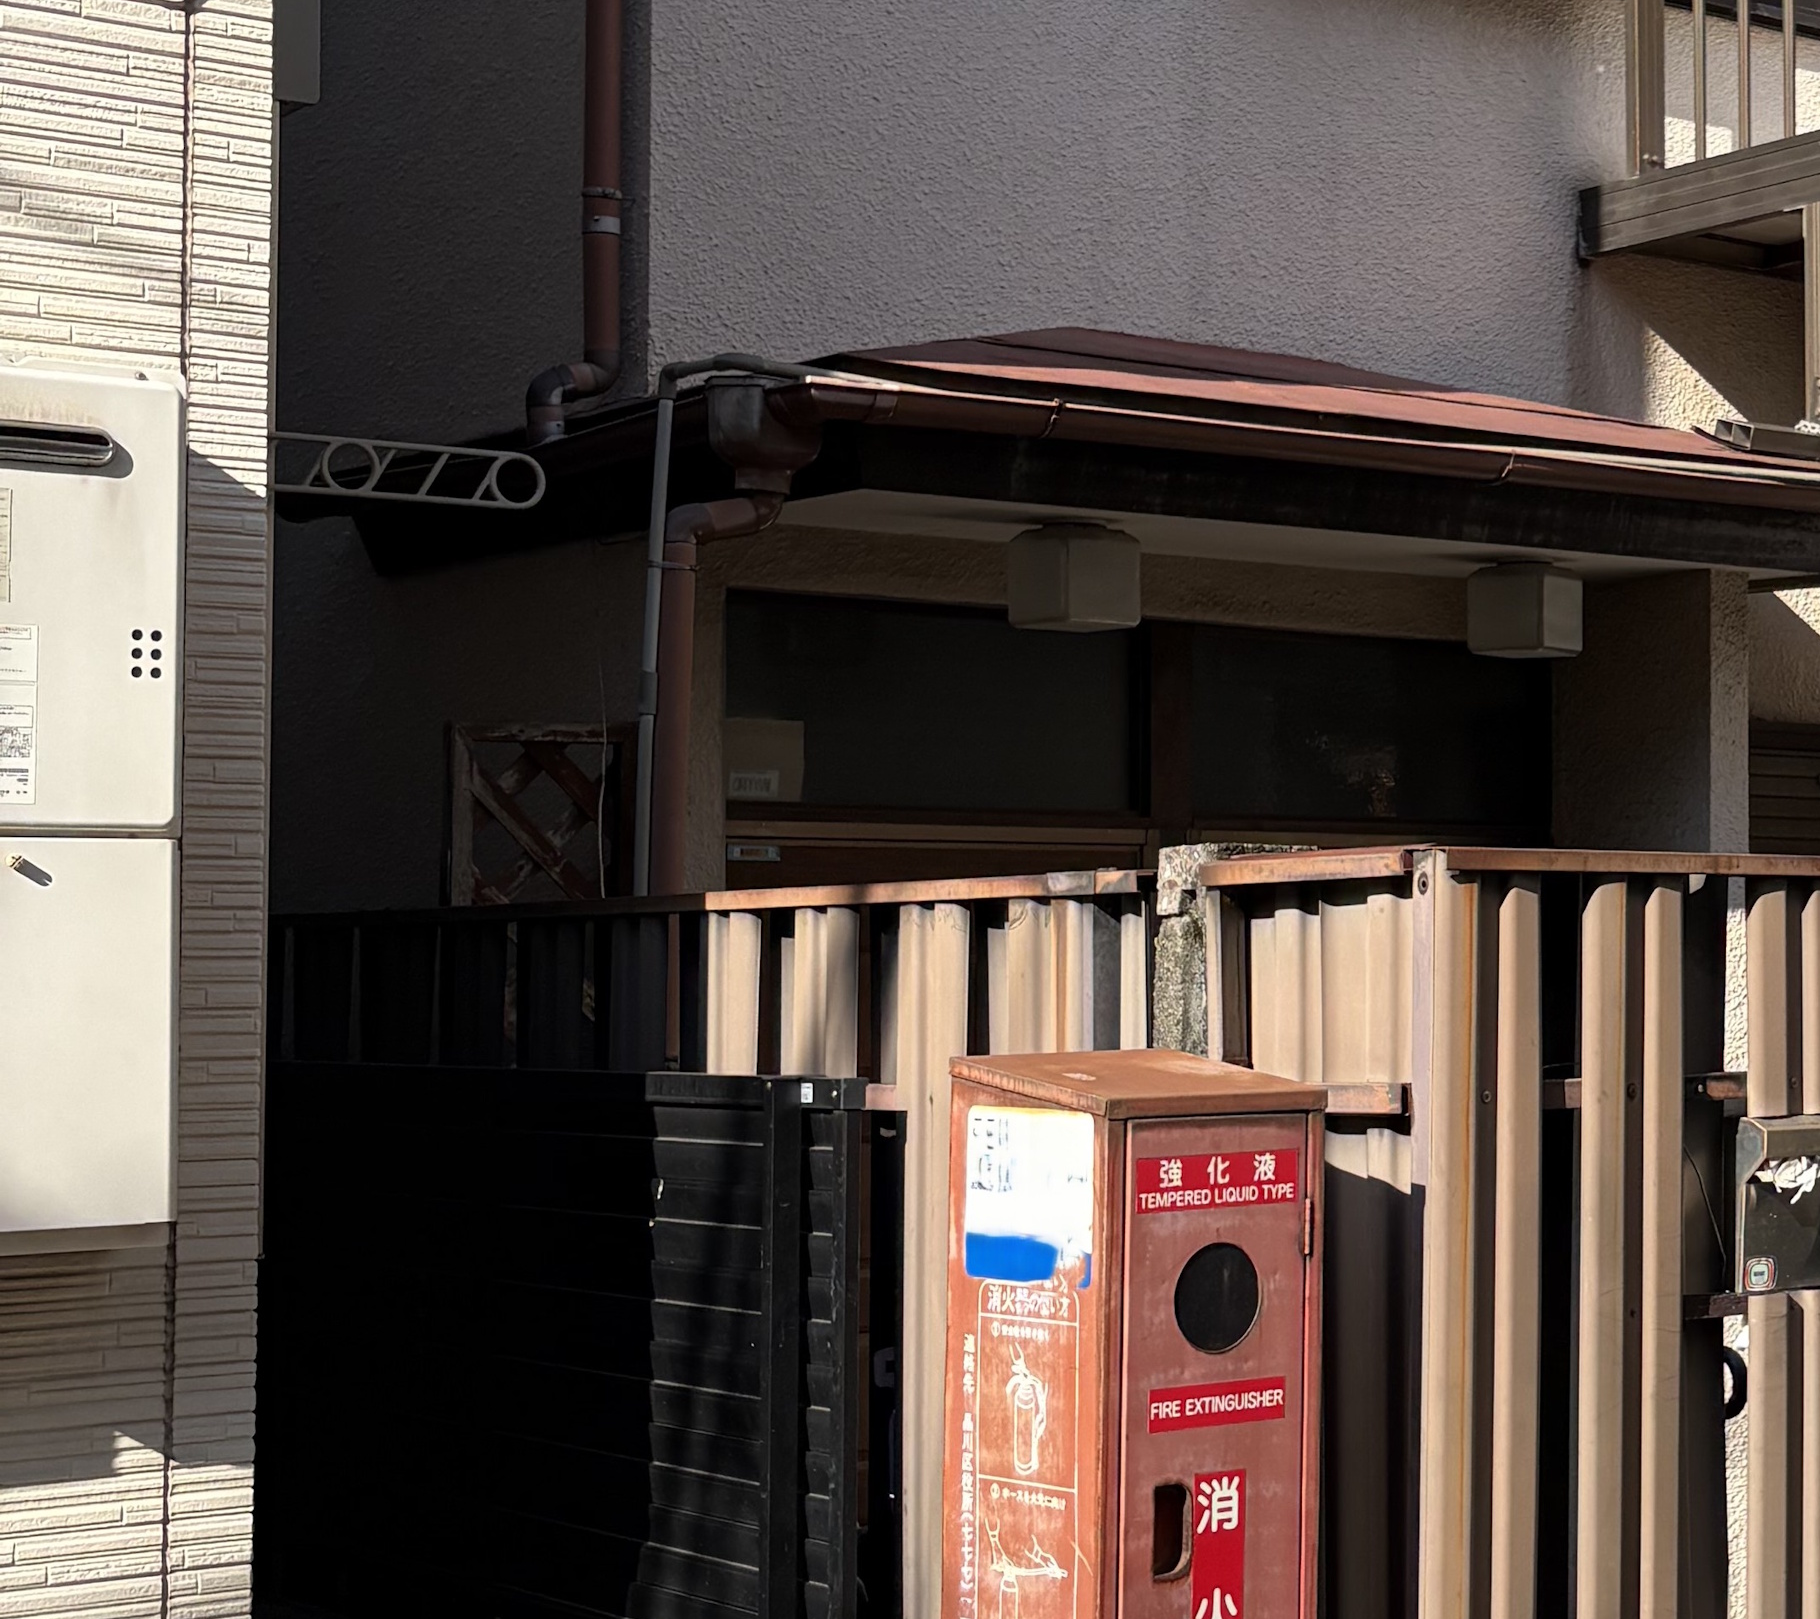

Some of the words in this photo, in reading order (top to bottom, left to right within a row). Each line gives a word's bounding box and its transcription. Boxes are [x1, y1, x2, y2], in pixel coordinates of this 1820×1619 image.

[1159, 1152, 1276, 1188] 強化液
[1139, 1188, 1211, 1210] TEMPERED
[1214, 1186, 1258, 1204] LIQUID
[1261, 1183, 1295, 1200] TYPE
[1150, 1400, 1181, 1421] FIRE
[1185, 1388, 1284, 1416] EXTINGUISHER
